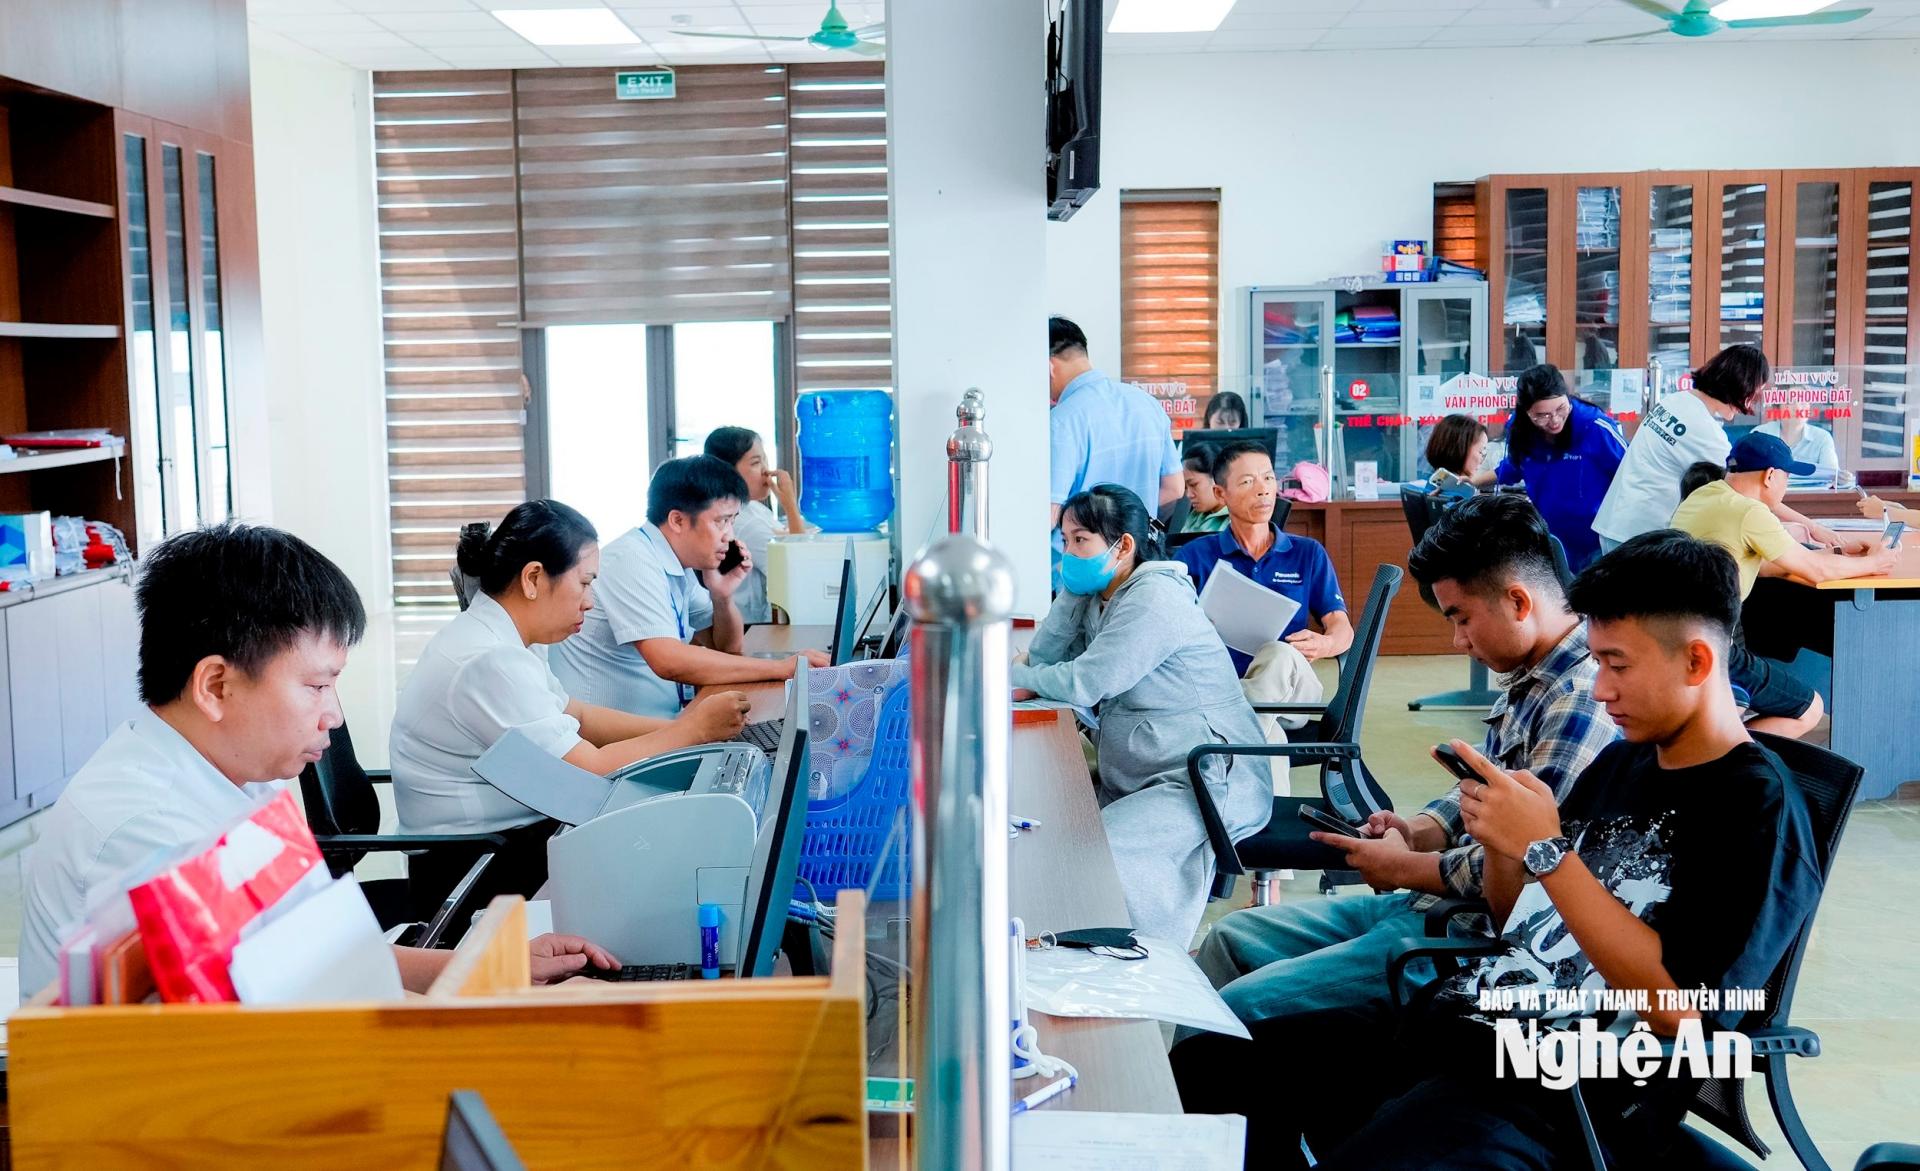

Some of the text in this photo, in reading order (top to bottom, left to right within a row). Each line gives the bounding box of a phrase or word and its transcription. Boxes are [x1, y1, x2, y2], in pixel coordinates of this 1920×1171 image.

[627, 76, 665, 87] EXIT
[1810, 371, 1839, 387] VỰC
[1352, 383, 1367, 397] 02
[1763, 384, 1852, 404] VĂN PHÒNG ĐẤT
[1174, 395, 1197, 414] ĐẤT
